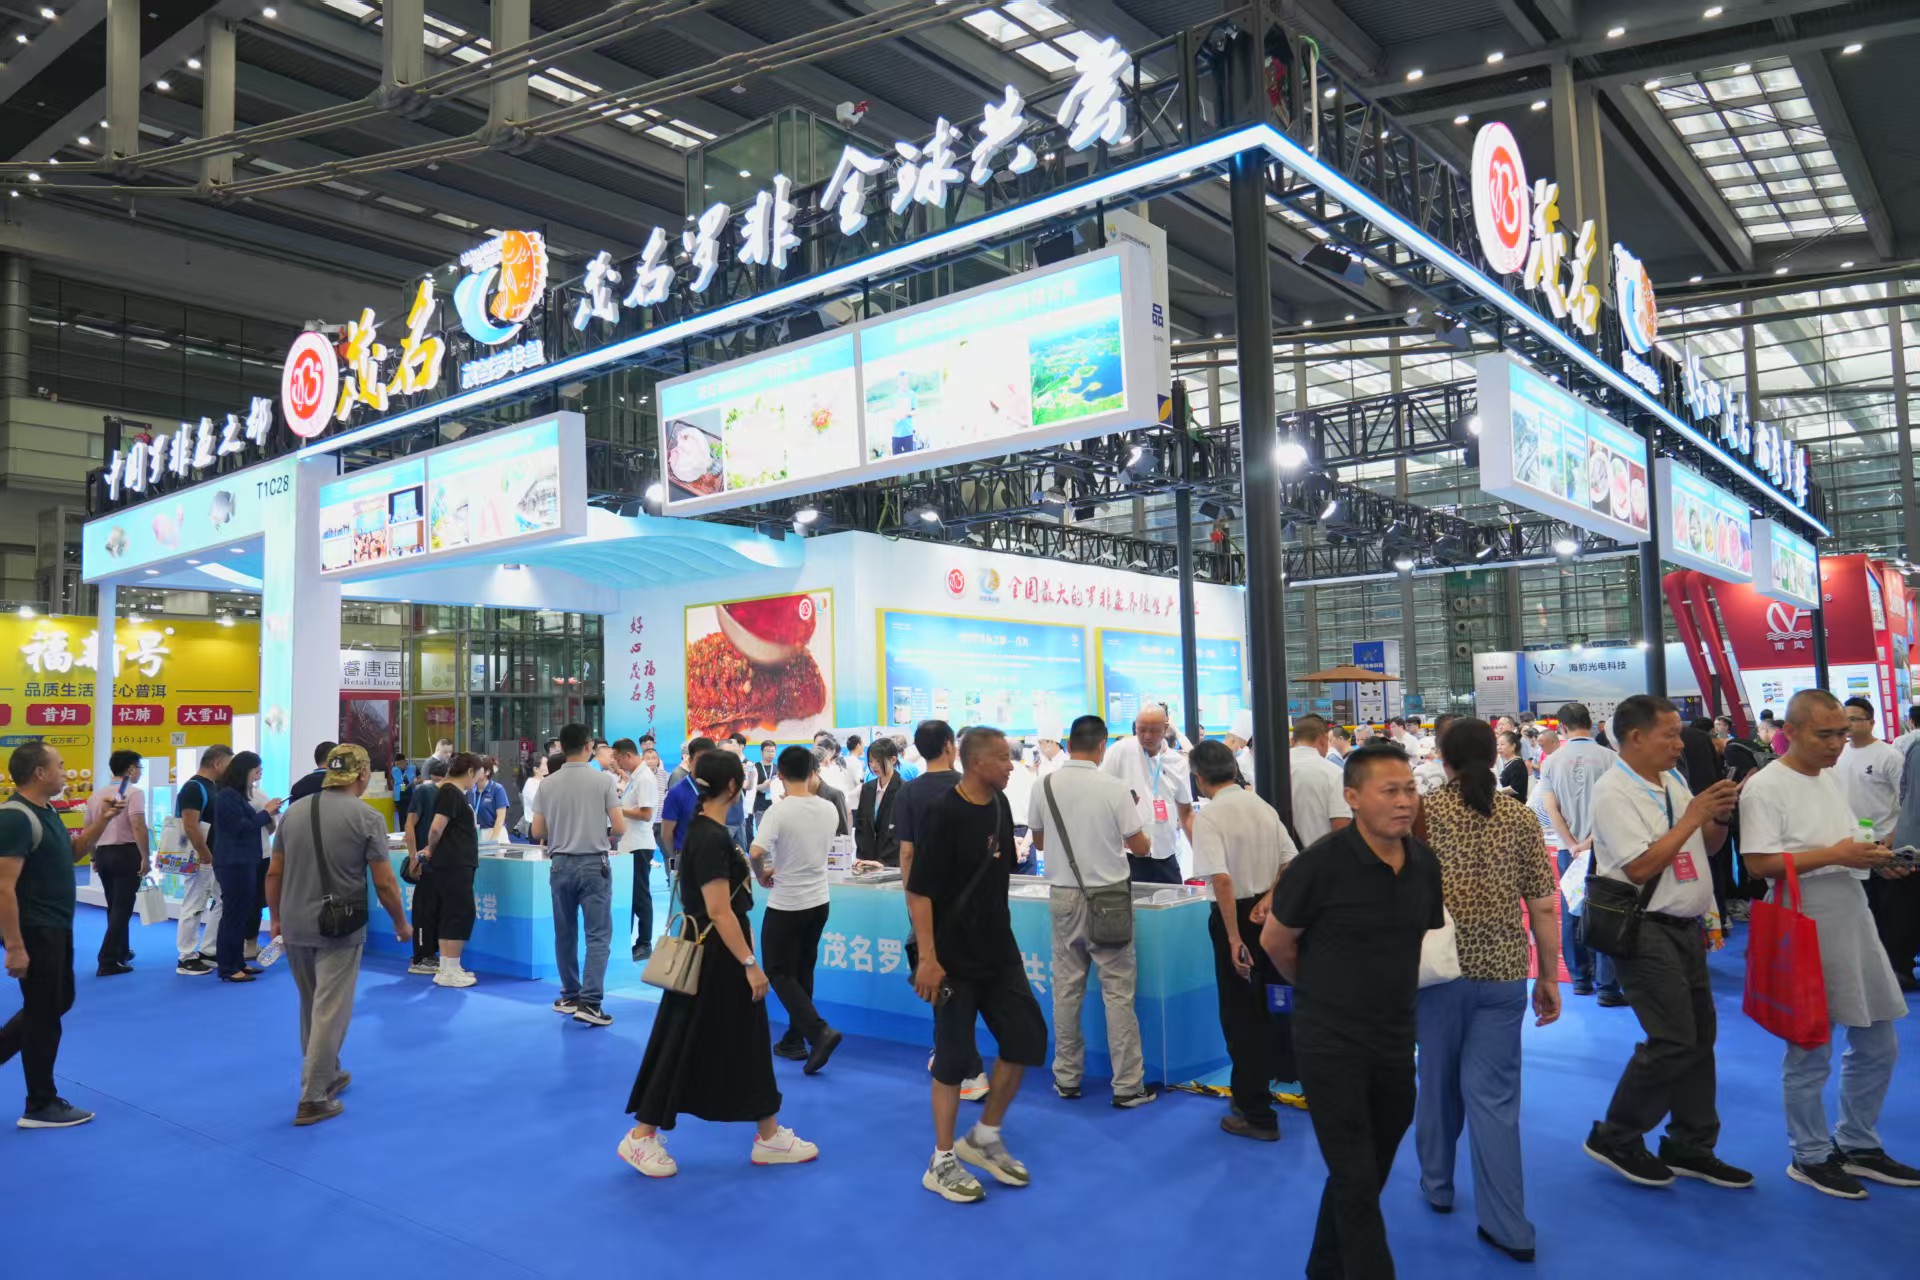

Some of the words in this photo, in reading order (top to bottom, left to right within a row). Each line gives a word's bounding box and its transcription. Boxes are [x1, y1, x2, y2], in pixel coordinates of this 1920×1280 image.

[336, 278, 445, 421] 茂名
[104, 396, 273, 500] 中国罗非鱼之都
[257, 475, 289, 499] T1C28
[1008, 576, 1200, 618] 全国最大的罗非鱼养殖生产
[629, 616, 644, 702] 好心茂名
[1568, 660, 1627, 673] 海豹光电科技
[344, 660, 409, 678] 睿唐国
[24, 682, 94, 698] 品质生活
[42, 706, 77, 723] 昔归
[118, 707, 151, 723] 忙肺
[184, 707, 228, 723] 大雪山
